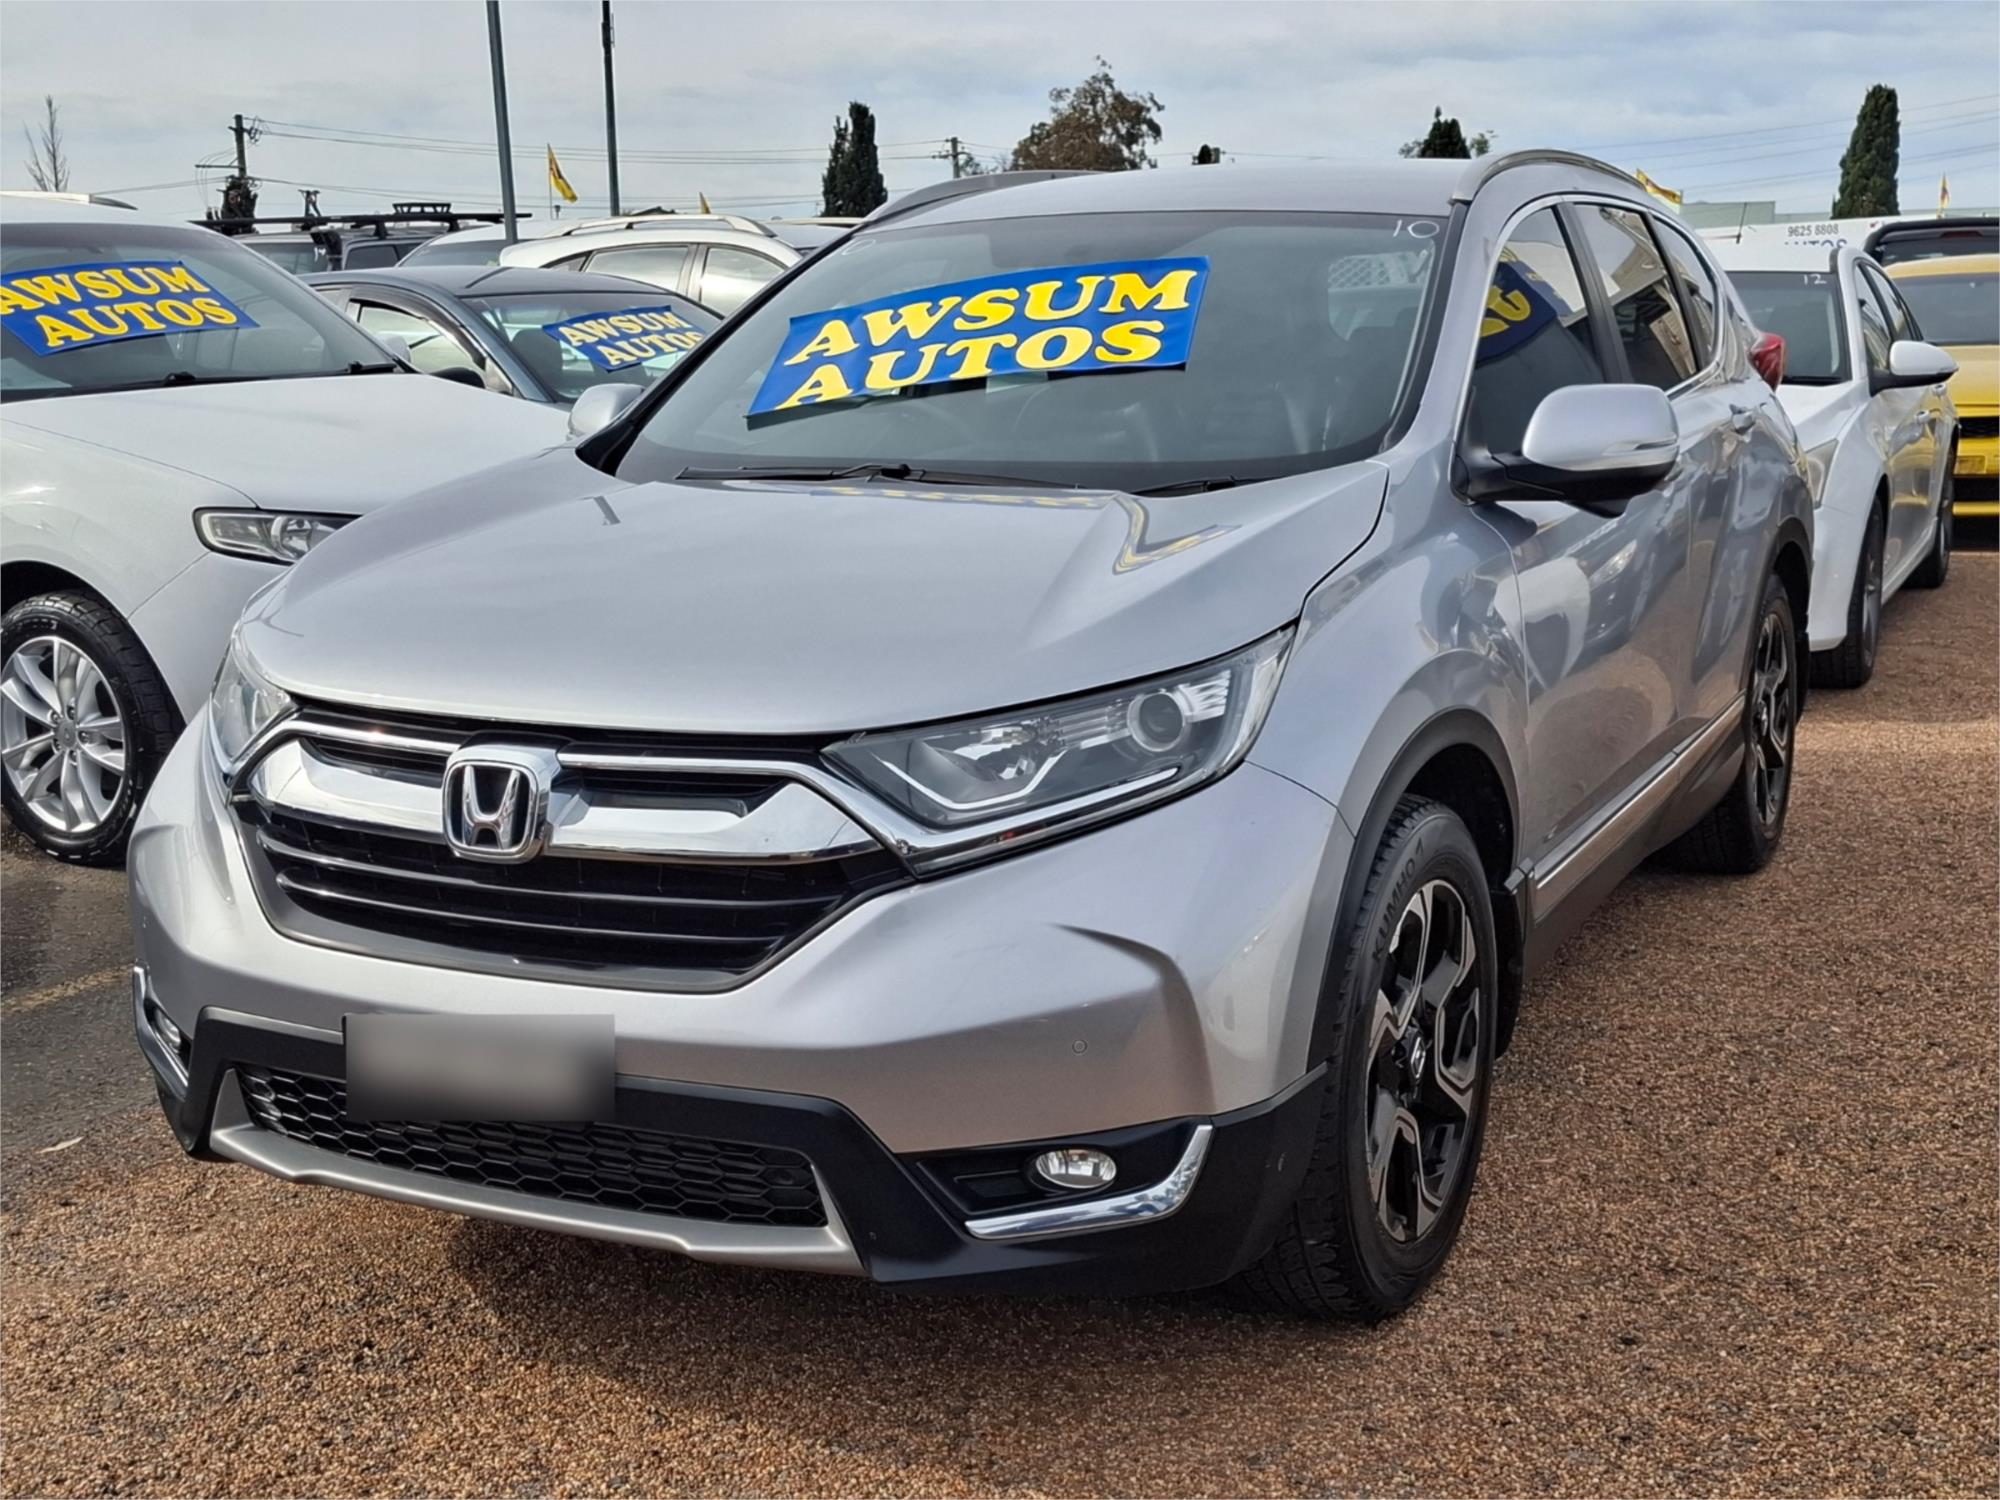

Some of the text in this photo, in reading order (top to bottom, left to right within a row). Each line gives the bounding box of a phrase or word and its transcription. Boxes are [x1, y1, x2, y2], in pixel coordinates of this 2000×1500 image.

[1393, 219, 1440, 239] 10
[1787, 225, 1813, 237] 9625
[0, 267, 210, 315] AWSUM
[1803, 273, 1827, 286] 12
[35, 297, 238, 347] AUTOS
[558, 311, 693, 347] AWSUM
[783, 269, 1198, 367] AWSUM
[774, 320, 1166, 410] AUTOS
